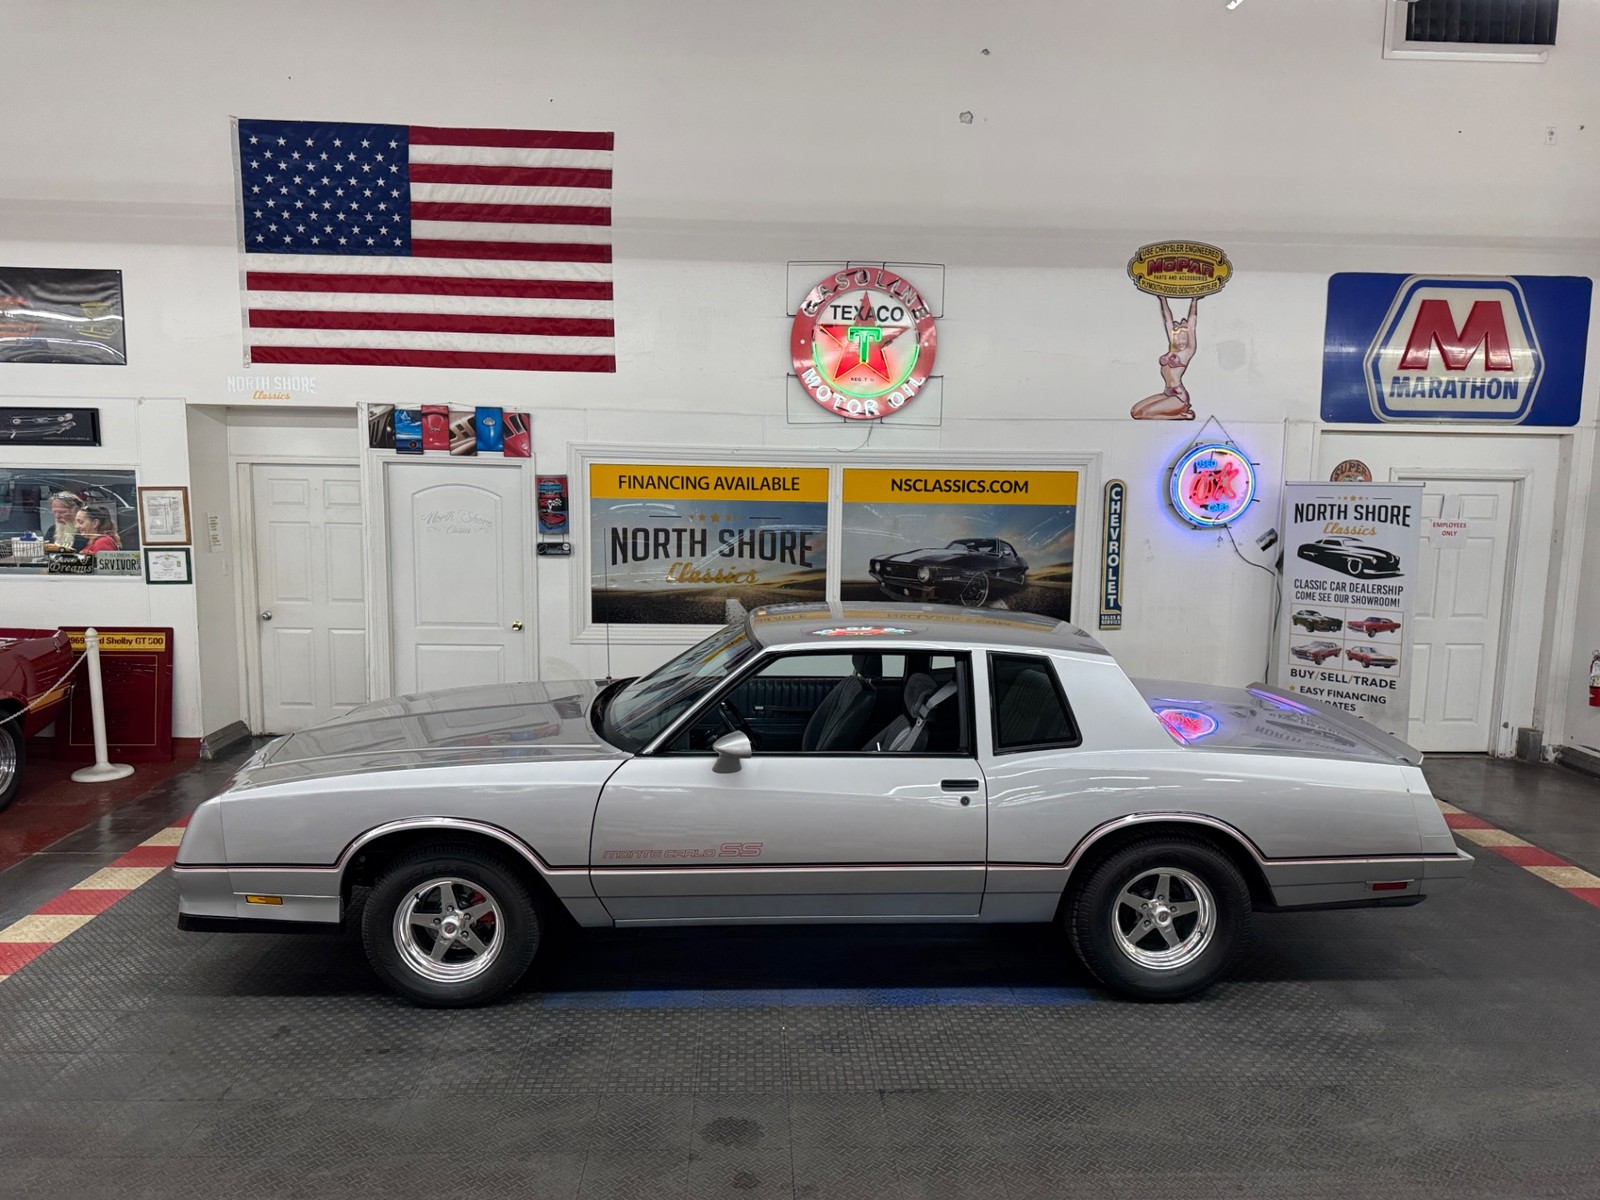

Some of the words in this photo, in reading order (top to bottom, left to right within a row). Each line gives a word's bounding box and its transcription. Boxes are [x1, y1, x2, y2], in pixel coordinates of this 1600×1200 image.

[1142, 248, 1153, 256] USE
[1155, 244, 1184, 254] CHRYSLER
[1185, 243, 1219, 258] ENGINEERED
[1147, 256, 1215, 278] MOPAR
[802, 269, 929, 322] GASOLINE
[830, 305, 904, 322] TEXACO
[227, 376, 270, 393] NORTH
[274, 376, 317, 394] SHORE
[802, 367, 880, 417] MOTOR
[888, 376, 926, 409] OIL
[1389, 375, 1519, 400] MARATHON
[618, 475, 710, 490] FINANCING
[714, 476, 800, 491] AVAILABLE
[891, 478, 1029, 494] NSCLASSICS.COM
[1294, 503, 1348, 524] NORTH
[1354, 504, 1411, 527] SHORE
[1323, 522, 1377, 535] Classics
[611, 527, 707, 566] NORTH
[718, 528, 813, 568] SHORE
[1108, 488, 1121, 607] CHEVROLET
[50, 563, 93, 573] Dreams
[99, 559, 137, 571] SRVIVOR
[665, 562, 759, 584] Classics
[1294, 579, 1327, 591] CLASSIC
[1330, 582, 1346, 592] CAR
[1349, 582, 1404, 596] DEALERSHIP
[1295, 591, 1316, 601] COME
[1318, 593, 1332, 602] SEE
[1334, 595, 1349, 604] OUR
[1350, 595, 1400, 607] SHOWROOM!
[106, 637, 133, 645] Shelby
[1300, 685, 1325, 696] EASY
[1327, 689, 1386, 704] FINANCING
[602, 850, 662, 859] MONTE
[664, 849, 716, 858] CARLO
[719, 842, 763, 858] SS
